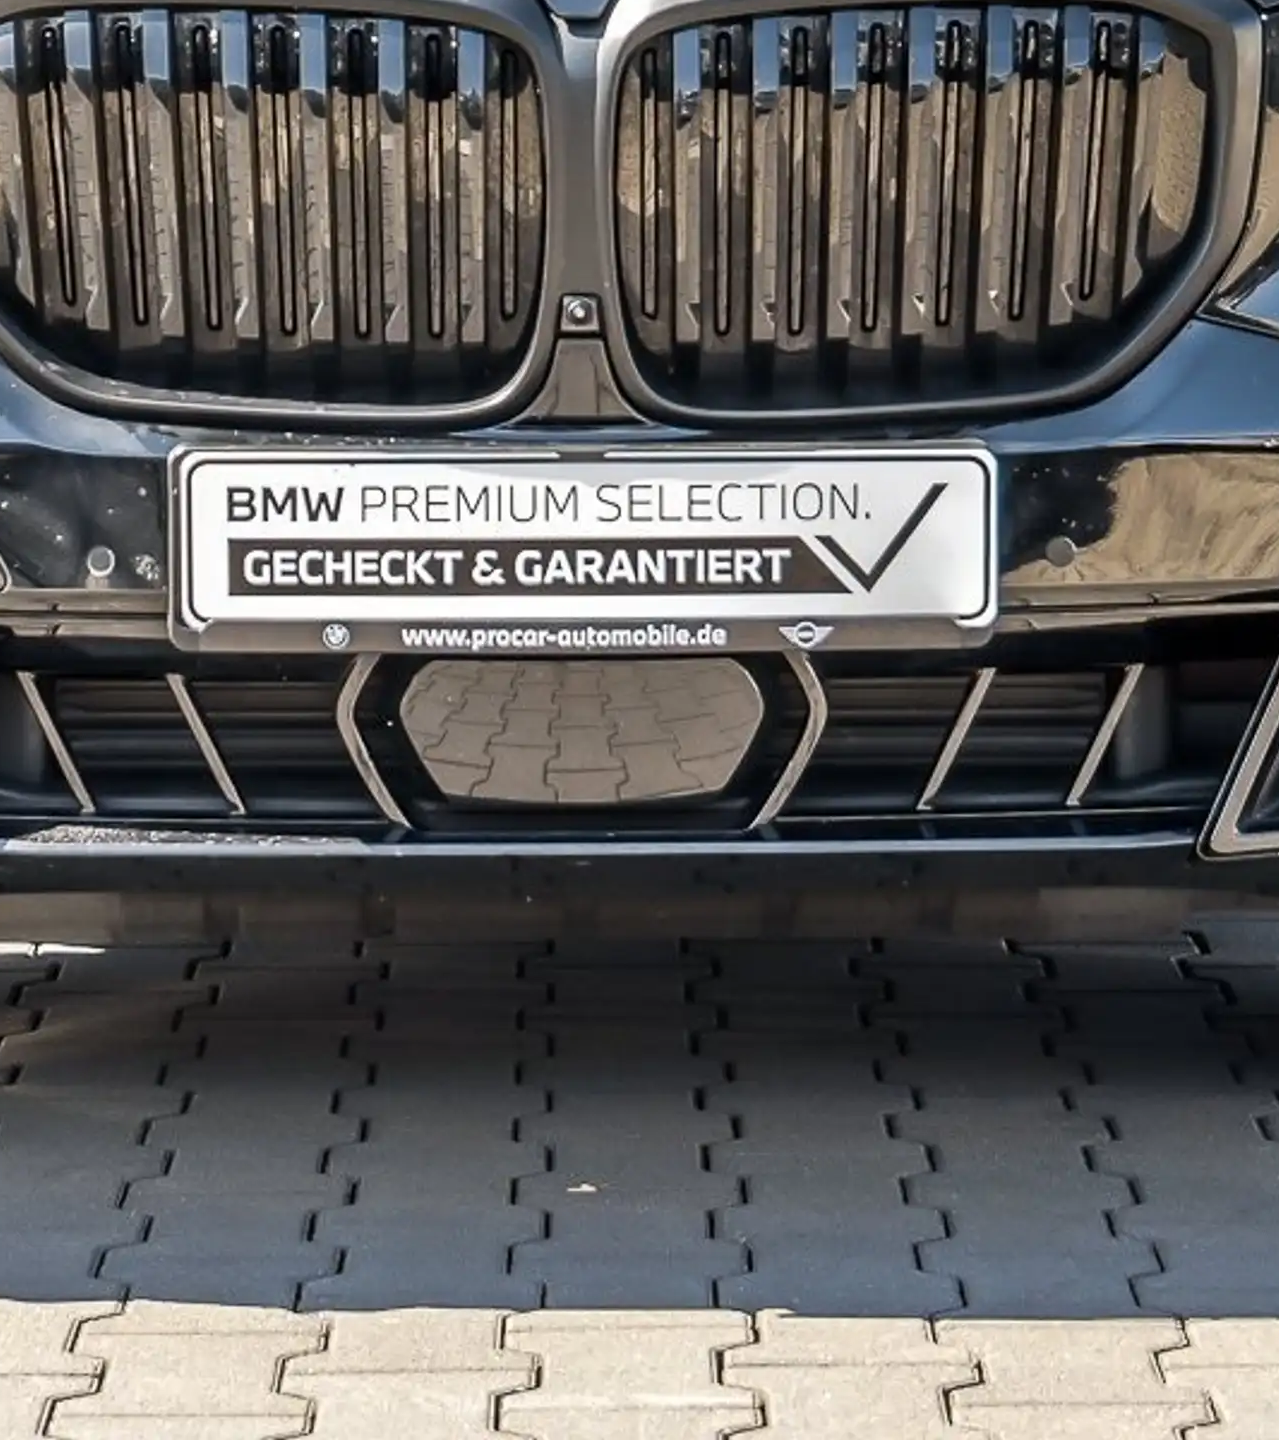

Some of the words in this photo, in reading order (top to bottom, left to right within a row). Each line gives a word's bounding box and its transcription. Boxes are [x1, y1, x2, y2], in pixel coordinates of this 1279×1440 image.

[226, 486, 344, 523] BMW
[360, 484, 579, 523] PREMIUM
[596, 482, 872, 522] SELECTION.
[242, 548, 463, 586] GECHECKT
[471, 548, 506, 586] &
[514, 547, 792, 586] GARANTIERT
[401, 623, 727, 651] www.procar-automobile.de
